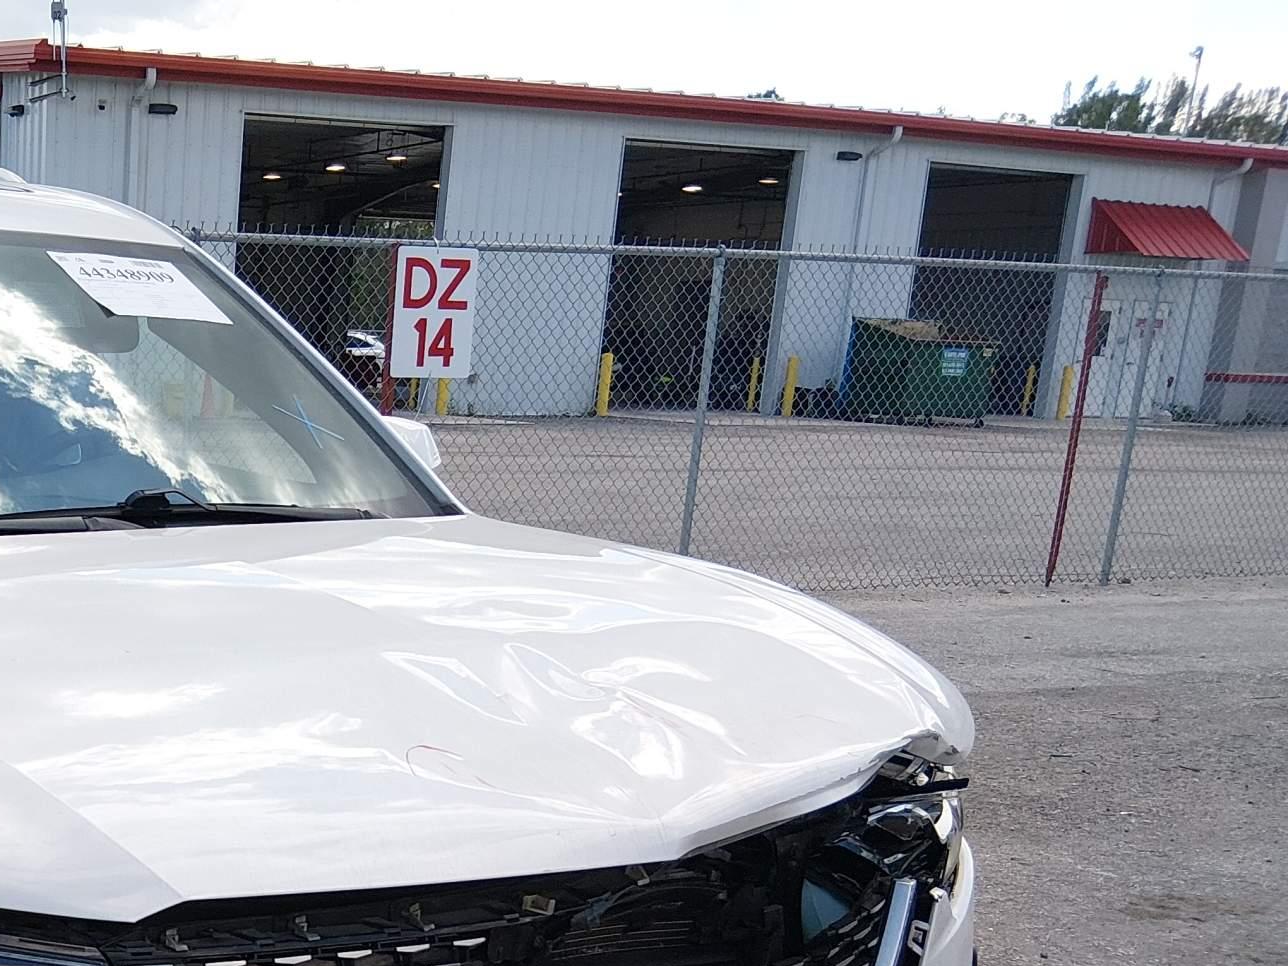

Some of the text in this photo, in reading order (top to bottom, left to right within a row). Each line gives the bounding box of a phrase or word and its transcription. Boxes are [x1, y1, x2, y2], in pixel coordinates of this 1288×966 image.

[80, 266, 175, 284] 44348909
[403, 257, 471, 311] DZ
[414, 318, 453, 368] 14
